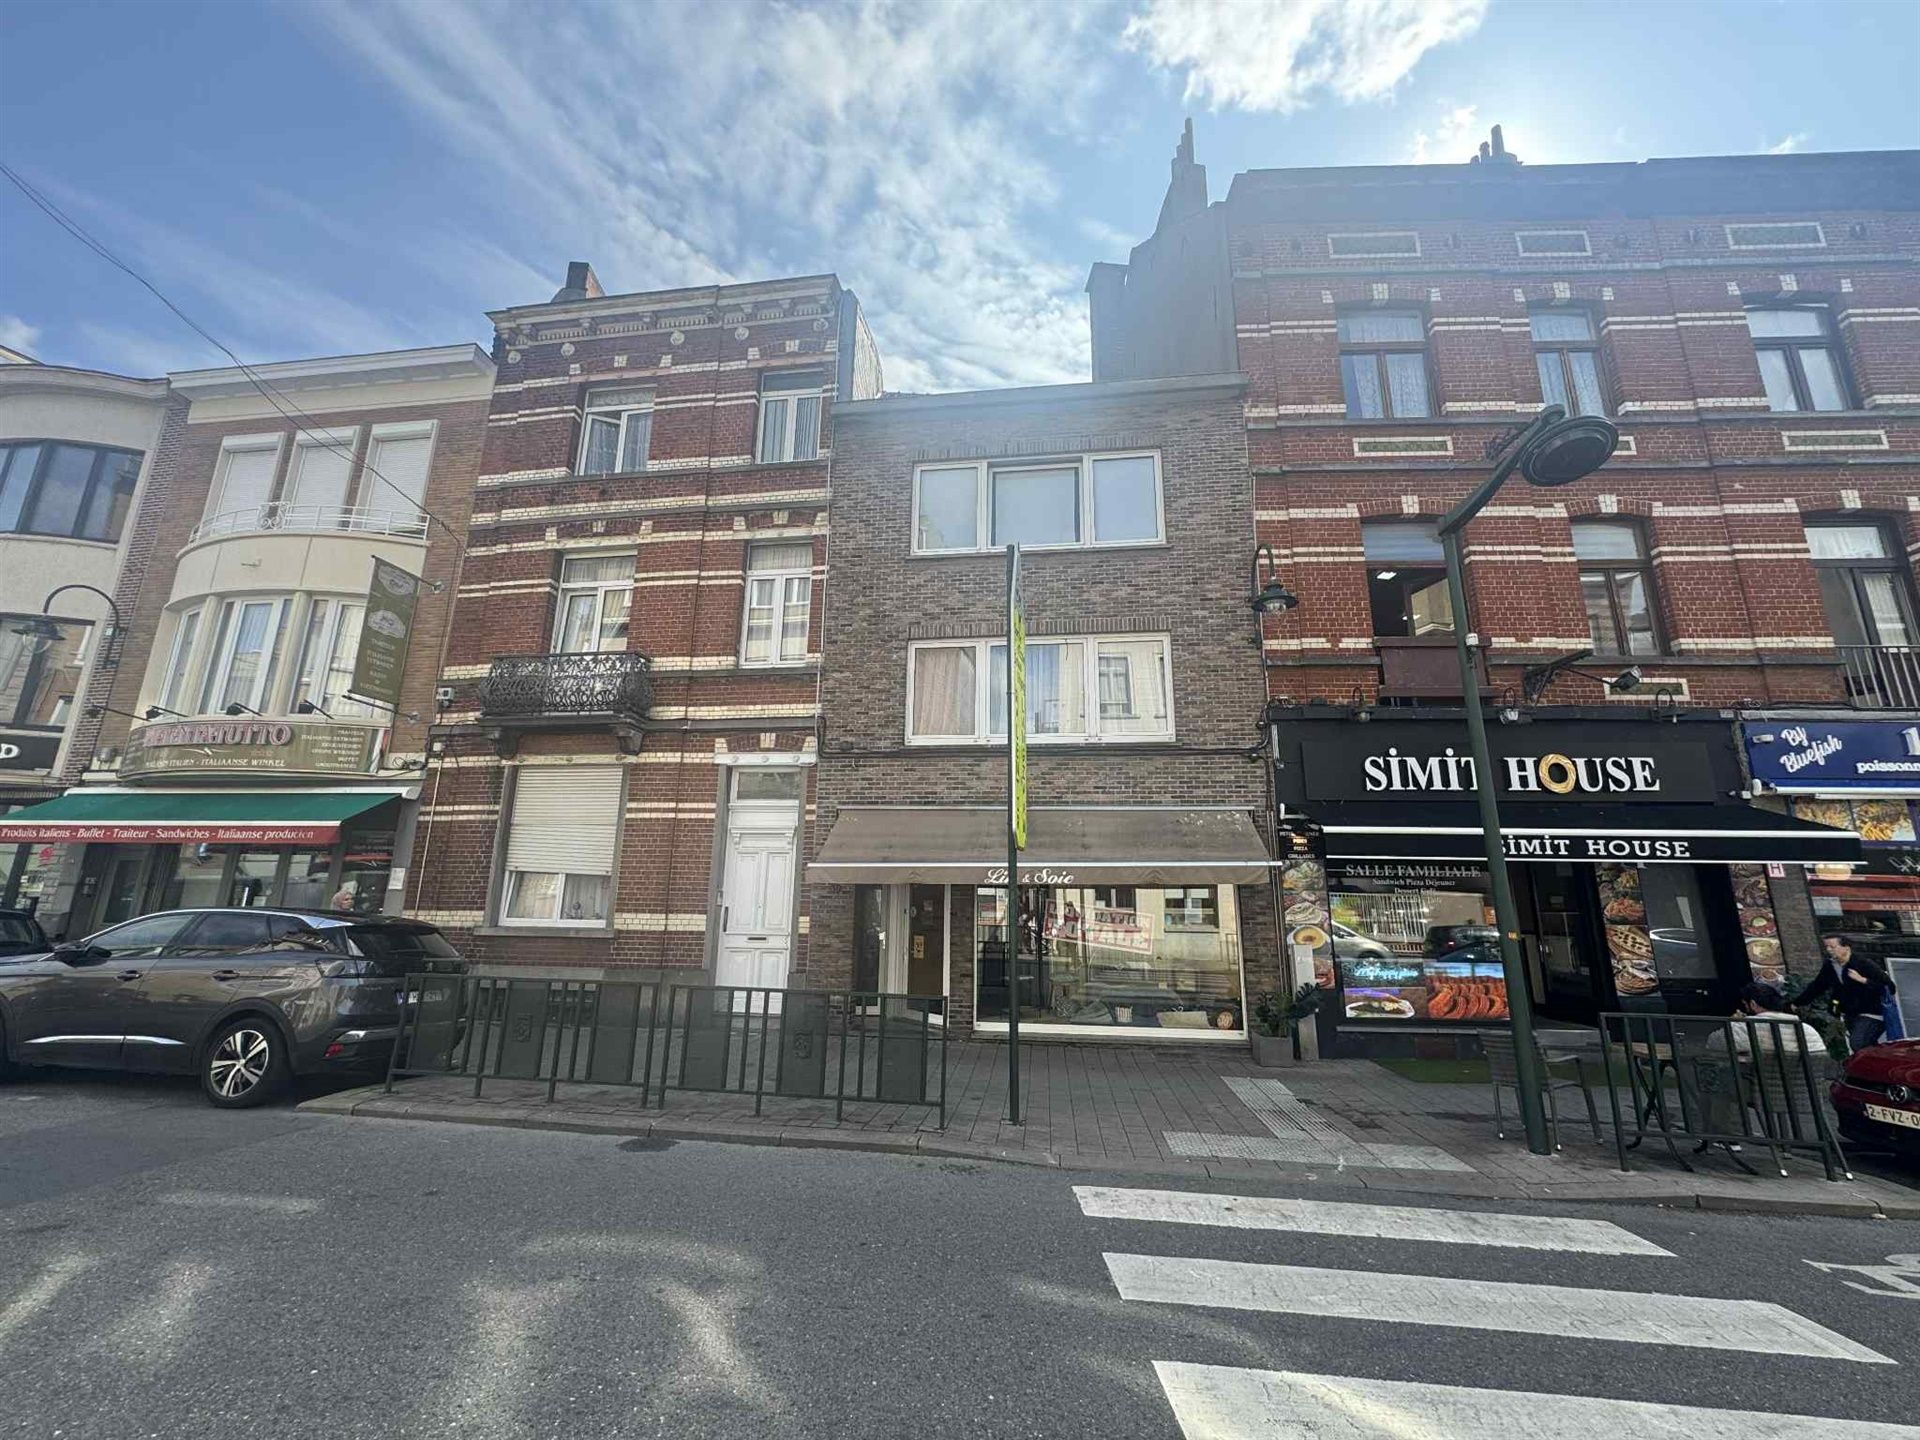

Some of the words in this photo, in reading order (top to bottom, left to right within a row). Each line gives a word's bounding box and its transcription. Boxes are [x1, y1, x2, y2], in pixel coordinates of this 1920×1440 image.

[1780, 726, 1809, 747] By
[1779, 735, 1842, 773] Bluefish
[200, 758, 249, 767] ITALIAANSE
[251, 758, 286, 768] WINKEL
[1504, 753, 1660, 794] HOUSE
[1, 828, 37, 838] Produits
[39, 828, 71, 838] italiens
[77, 828, 104, 839] Buffet
[113, 828, 149, 838] Traiteur
[155, 828, 210, 839] Sandwiches
[218, 828, 263, 839] Italiaanse
[1586, 840, 1691, 858] HOUSE
[1034, 868, 1075, 884] Soie
[1345, 864, 1394, 877] SALLE
[1397, 865, 1482, 878] FAMILIALE
[1372, 878, 1405, 886] Sandwich
